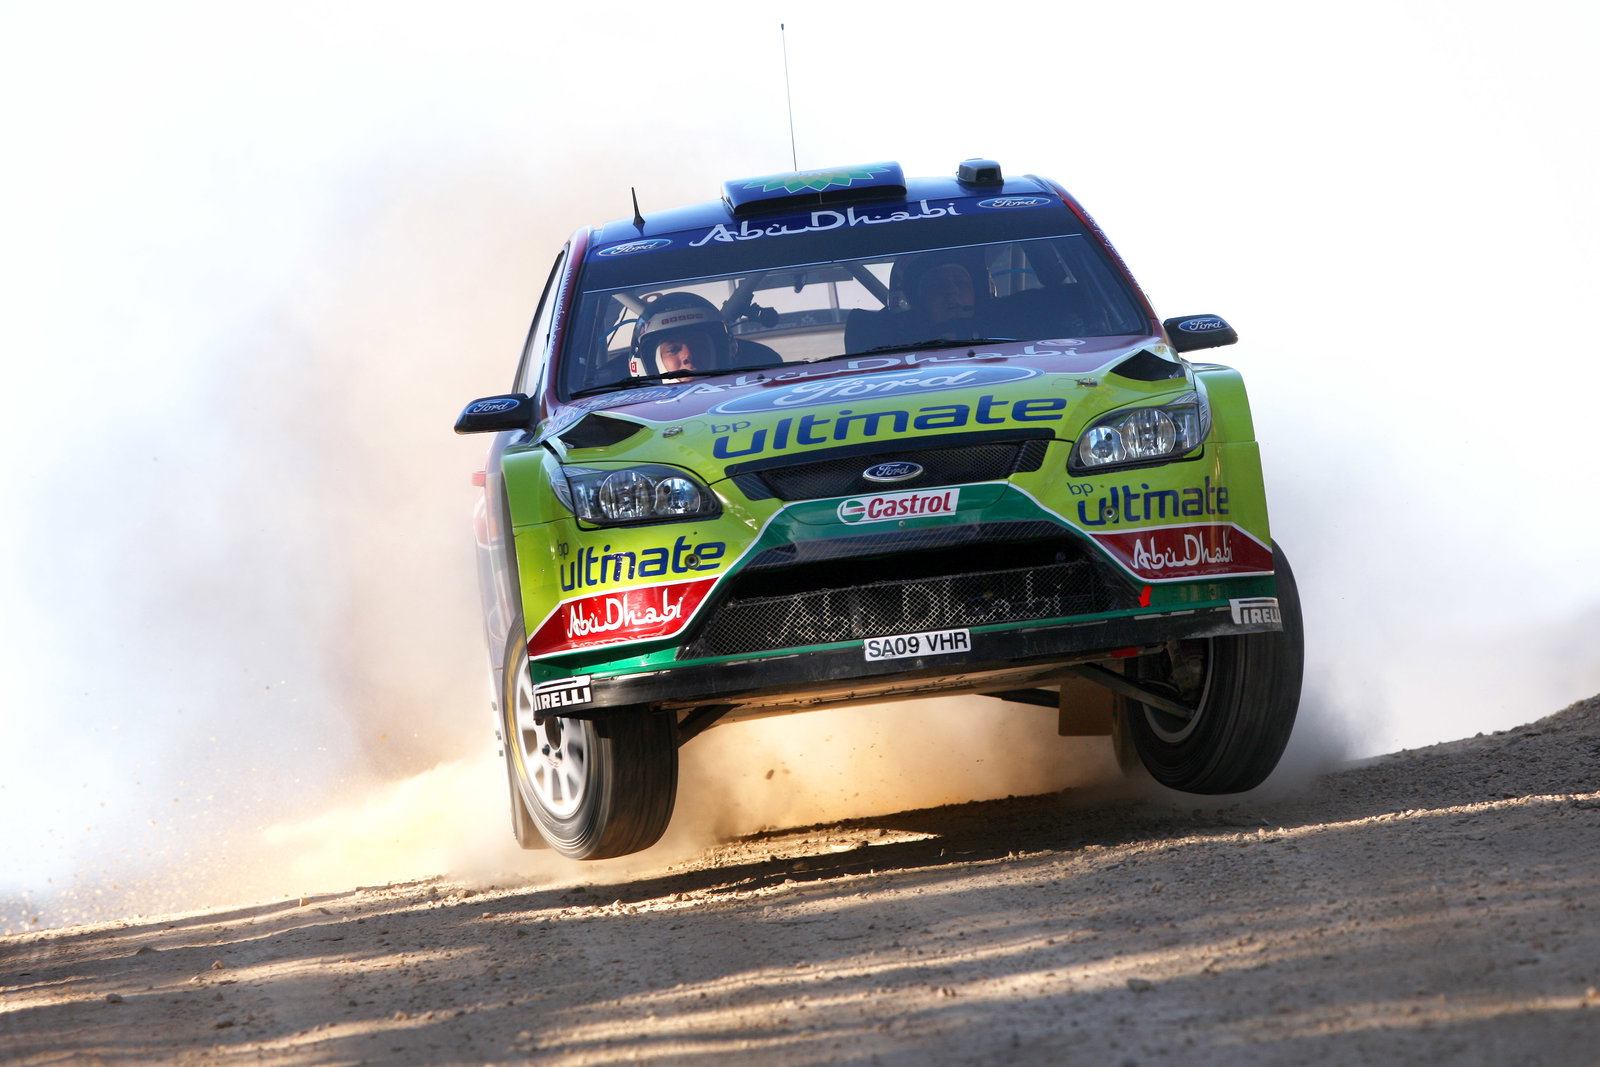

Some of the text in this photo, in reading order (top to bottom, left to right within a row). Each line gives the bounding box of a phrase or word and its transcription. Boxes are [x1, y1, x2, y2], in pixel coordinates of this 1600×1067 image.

[992, 198, 1037, 207] Ford
[611, 241, 658, 254] Ford
[1189, 320, 1222, 330] Ford
[774, 366, 976, 404] Ford
[472, 401, 508, 412] Ford
[710, 421, 752, 434] bp
[713, 395, 1068, 460] ultimate
[876, 464, 909, 477] Ford
[1067, 482, 1094, 497] bp
[867, 492, 951, 519] Castrol
[1078, 476, 1229, 526] ultimate
[560, 536, 725, 591] ultimate
[868, 631, 968, 658] SA09 VHR
